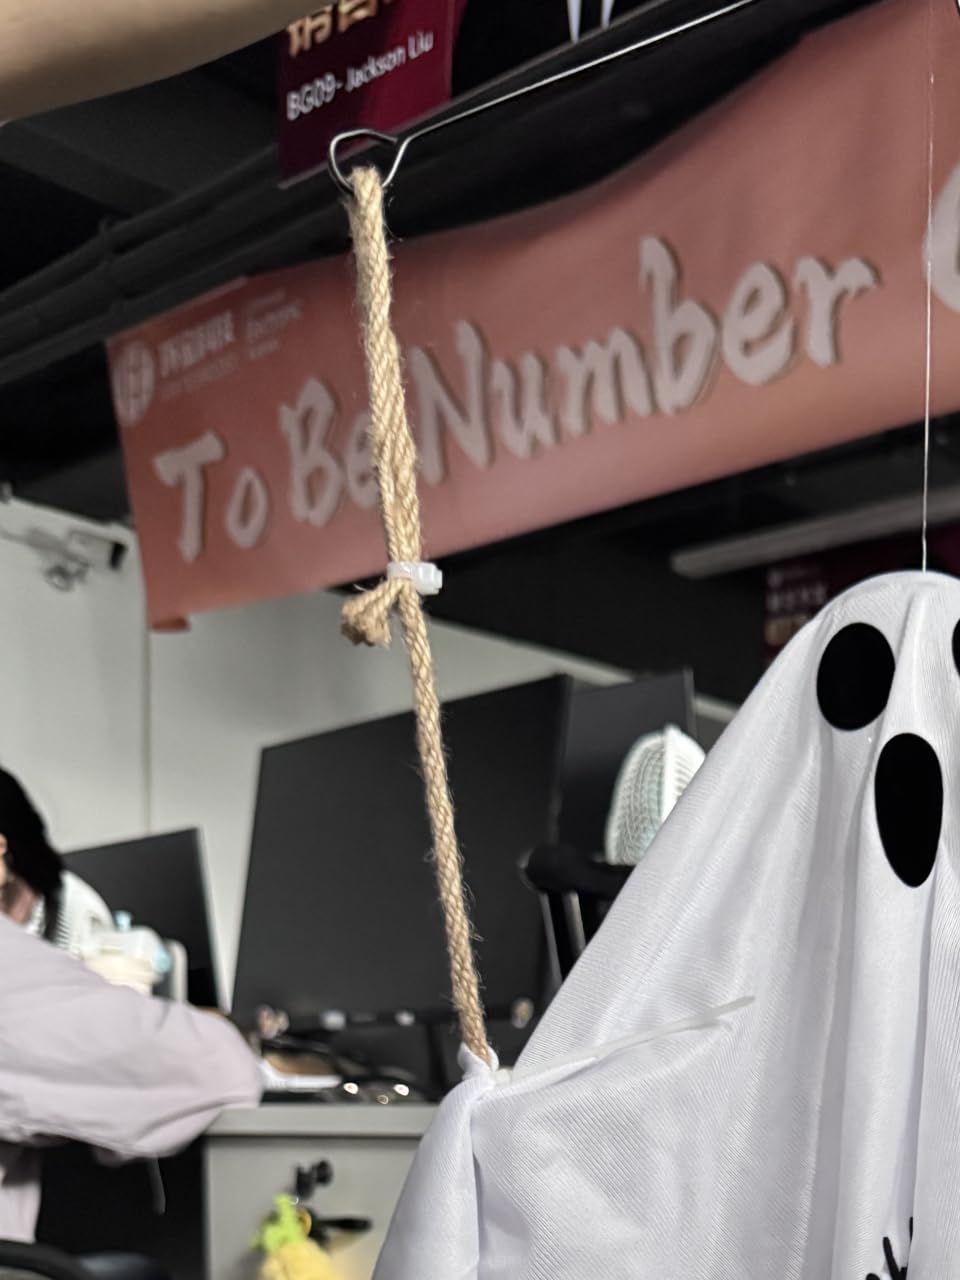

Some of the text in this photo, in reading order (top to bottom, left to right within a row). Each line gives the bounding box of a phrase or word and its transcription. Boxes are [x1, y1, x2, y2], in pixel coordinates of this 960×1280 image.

[345, 45, 406, 92] Jackson
[407, 31, 434, 60] Liu
[152, 430, 269, 563] To
[408, 234, 880, 487] Number
